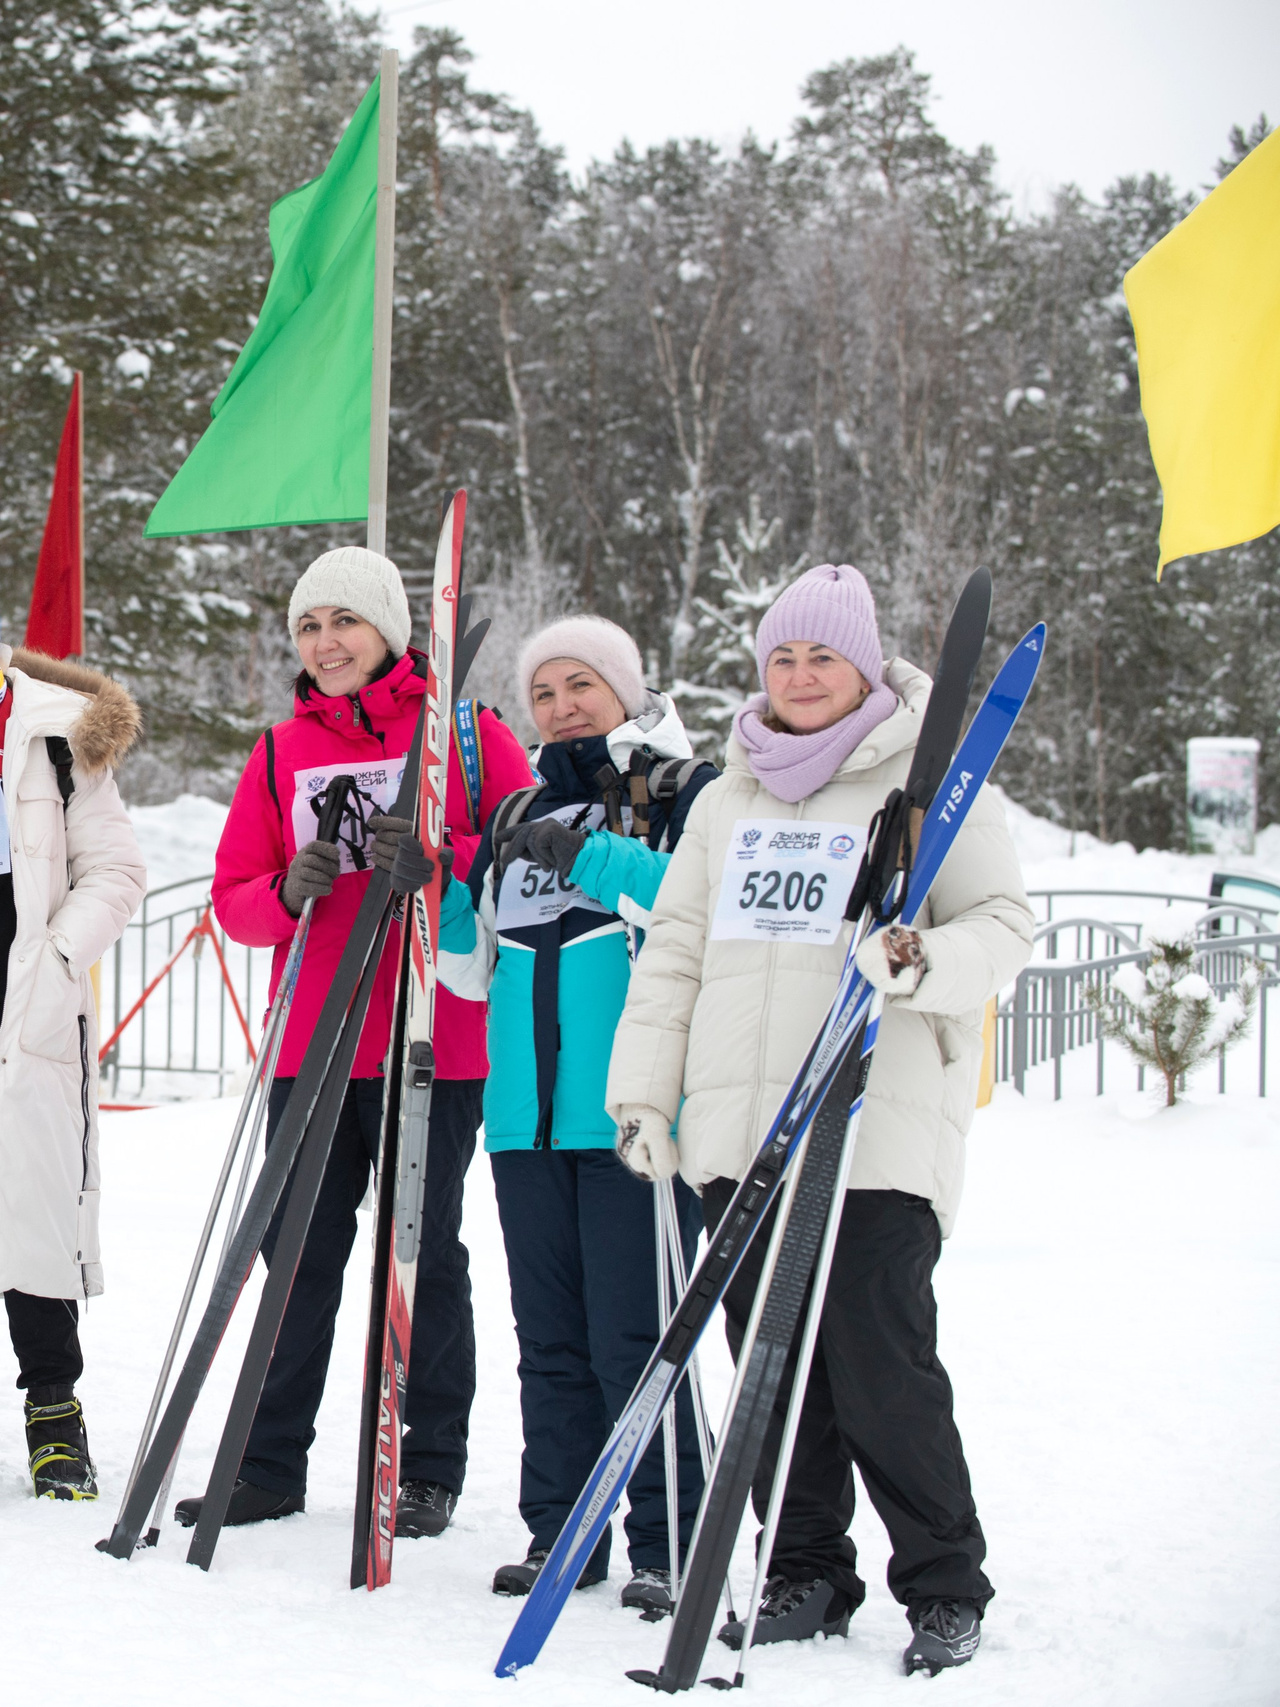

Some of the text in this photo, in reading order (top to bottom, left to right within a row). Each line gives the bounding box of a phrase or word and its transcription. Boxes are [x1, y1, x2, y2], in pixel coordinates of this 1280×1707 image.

[938, 770, 974, 824] TISA
[768, 840, 820, 850] РОССИИ
[772, 832, 821, 841] ЛЫЖНЯ
[739, 870, 827, 912] 5206
[394, 1360, 406, 1394] 185
[582, 1468, 616, 1534] Adventure
